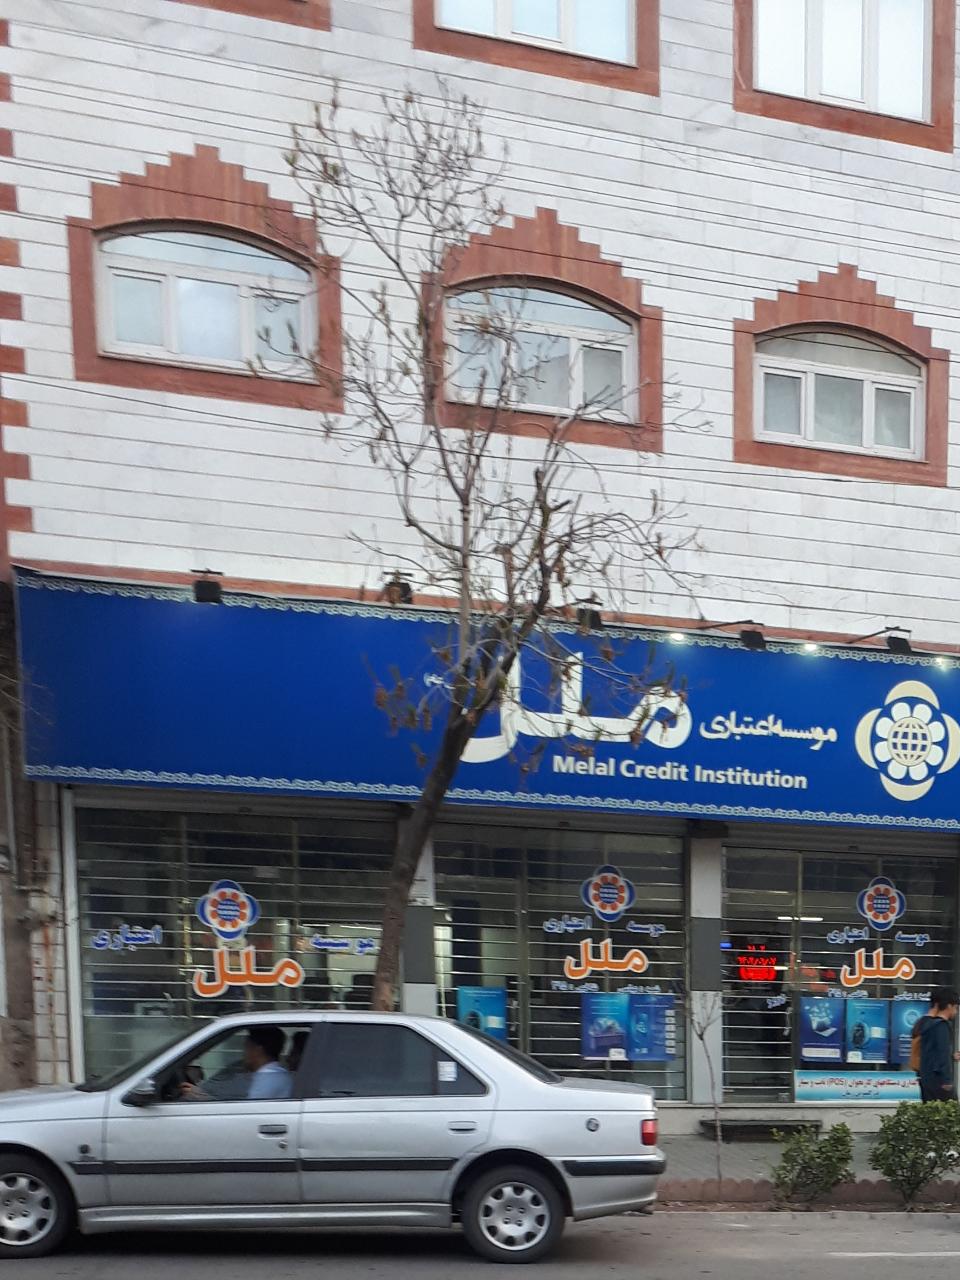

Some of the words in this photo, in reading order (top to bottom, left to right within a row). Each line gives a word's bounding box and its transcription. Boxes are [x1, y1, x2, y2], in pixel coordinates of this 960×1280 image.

[553, 754, 616, 778] Melal
[620, 759, 688, 781] Credit
[694, 765, 807, 789] Institution
[193, 945, 305, 998] ملل
[564, 937, 649, 979] ملل
[840, 947, 916, 988] ملل
